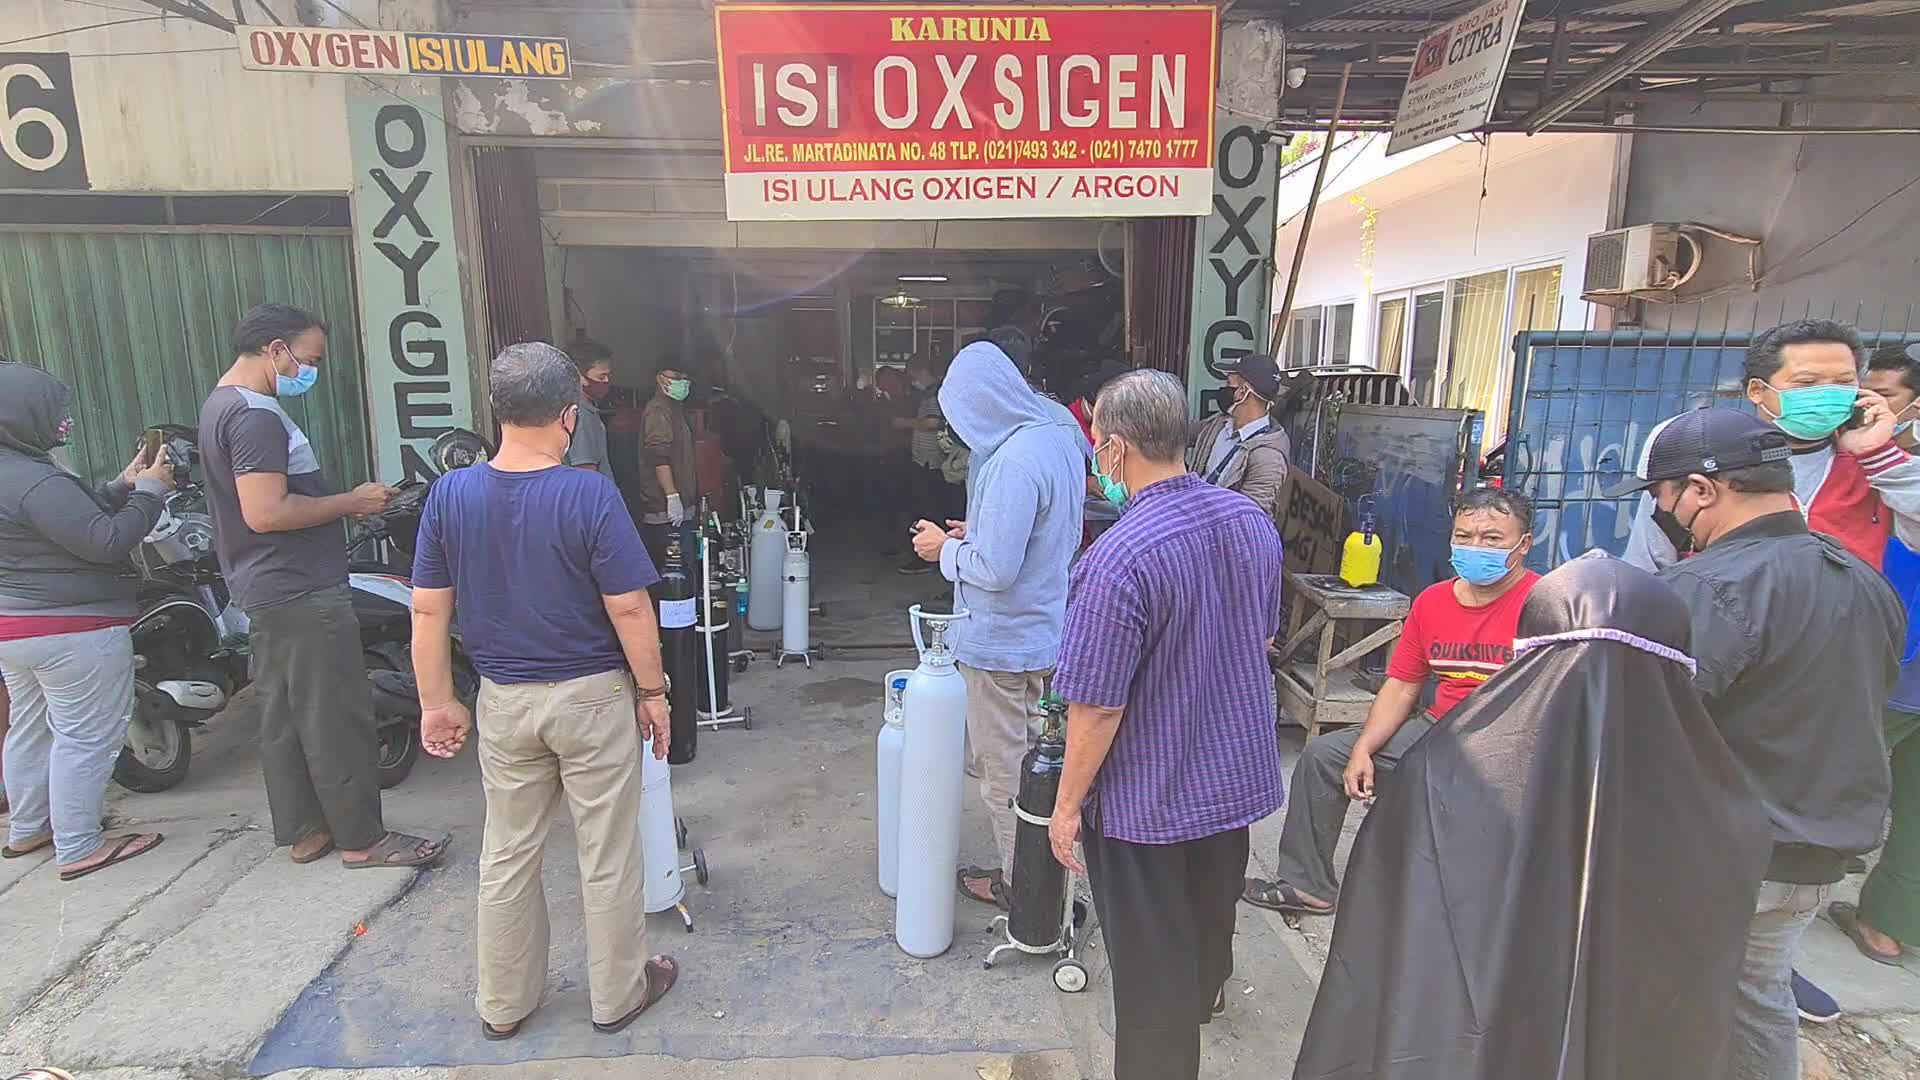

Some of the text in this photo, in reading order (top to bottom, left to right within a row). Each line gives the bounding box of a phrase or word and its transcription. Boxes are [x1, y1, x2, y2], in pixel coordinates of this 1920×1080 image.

[889, 17, 1052, 42] KARUNIA
[1448, 17, 1503, 65] CITRA
[249, 31, 401, 69] OXYGEN
[753, 54, 1187, 131] ISI OXSIGEN
[744, 144, 789, 163] JL.RE.
[792, 142, 897, 163] MARTADINATA
[900, 142, 926, 161] NO.
[929, 141, 946, 160] 48
[950, 140, 979, 160] TLP.
[1052, 139, 1078, 159] 342
[1090, 139, 1124, 163] (021)
[1128, 139, 1162, 159] 7470
[1166, 139, 1199, 159] 1777
[763, 178, 798, 202] ISI
[807, 177, 914, 201] ULANG
[922, 175, 1037, 200] OXIGEN
[1071, 175, 1180, 199] ARGON
